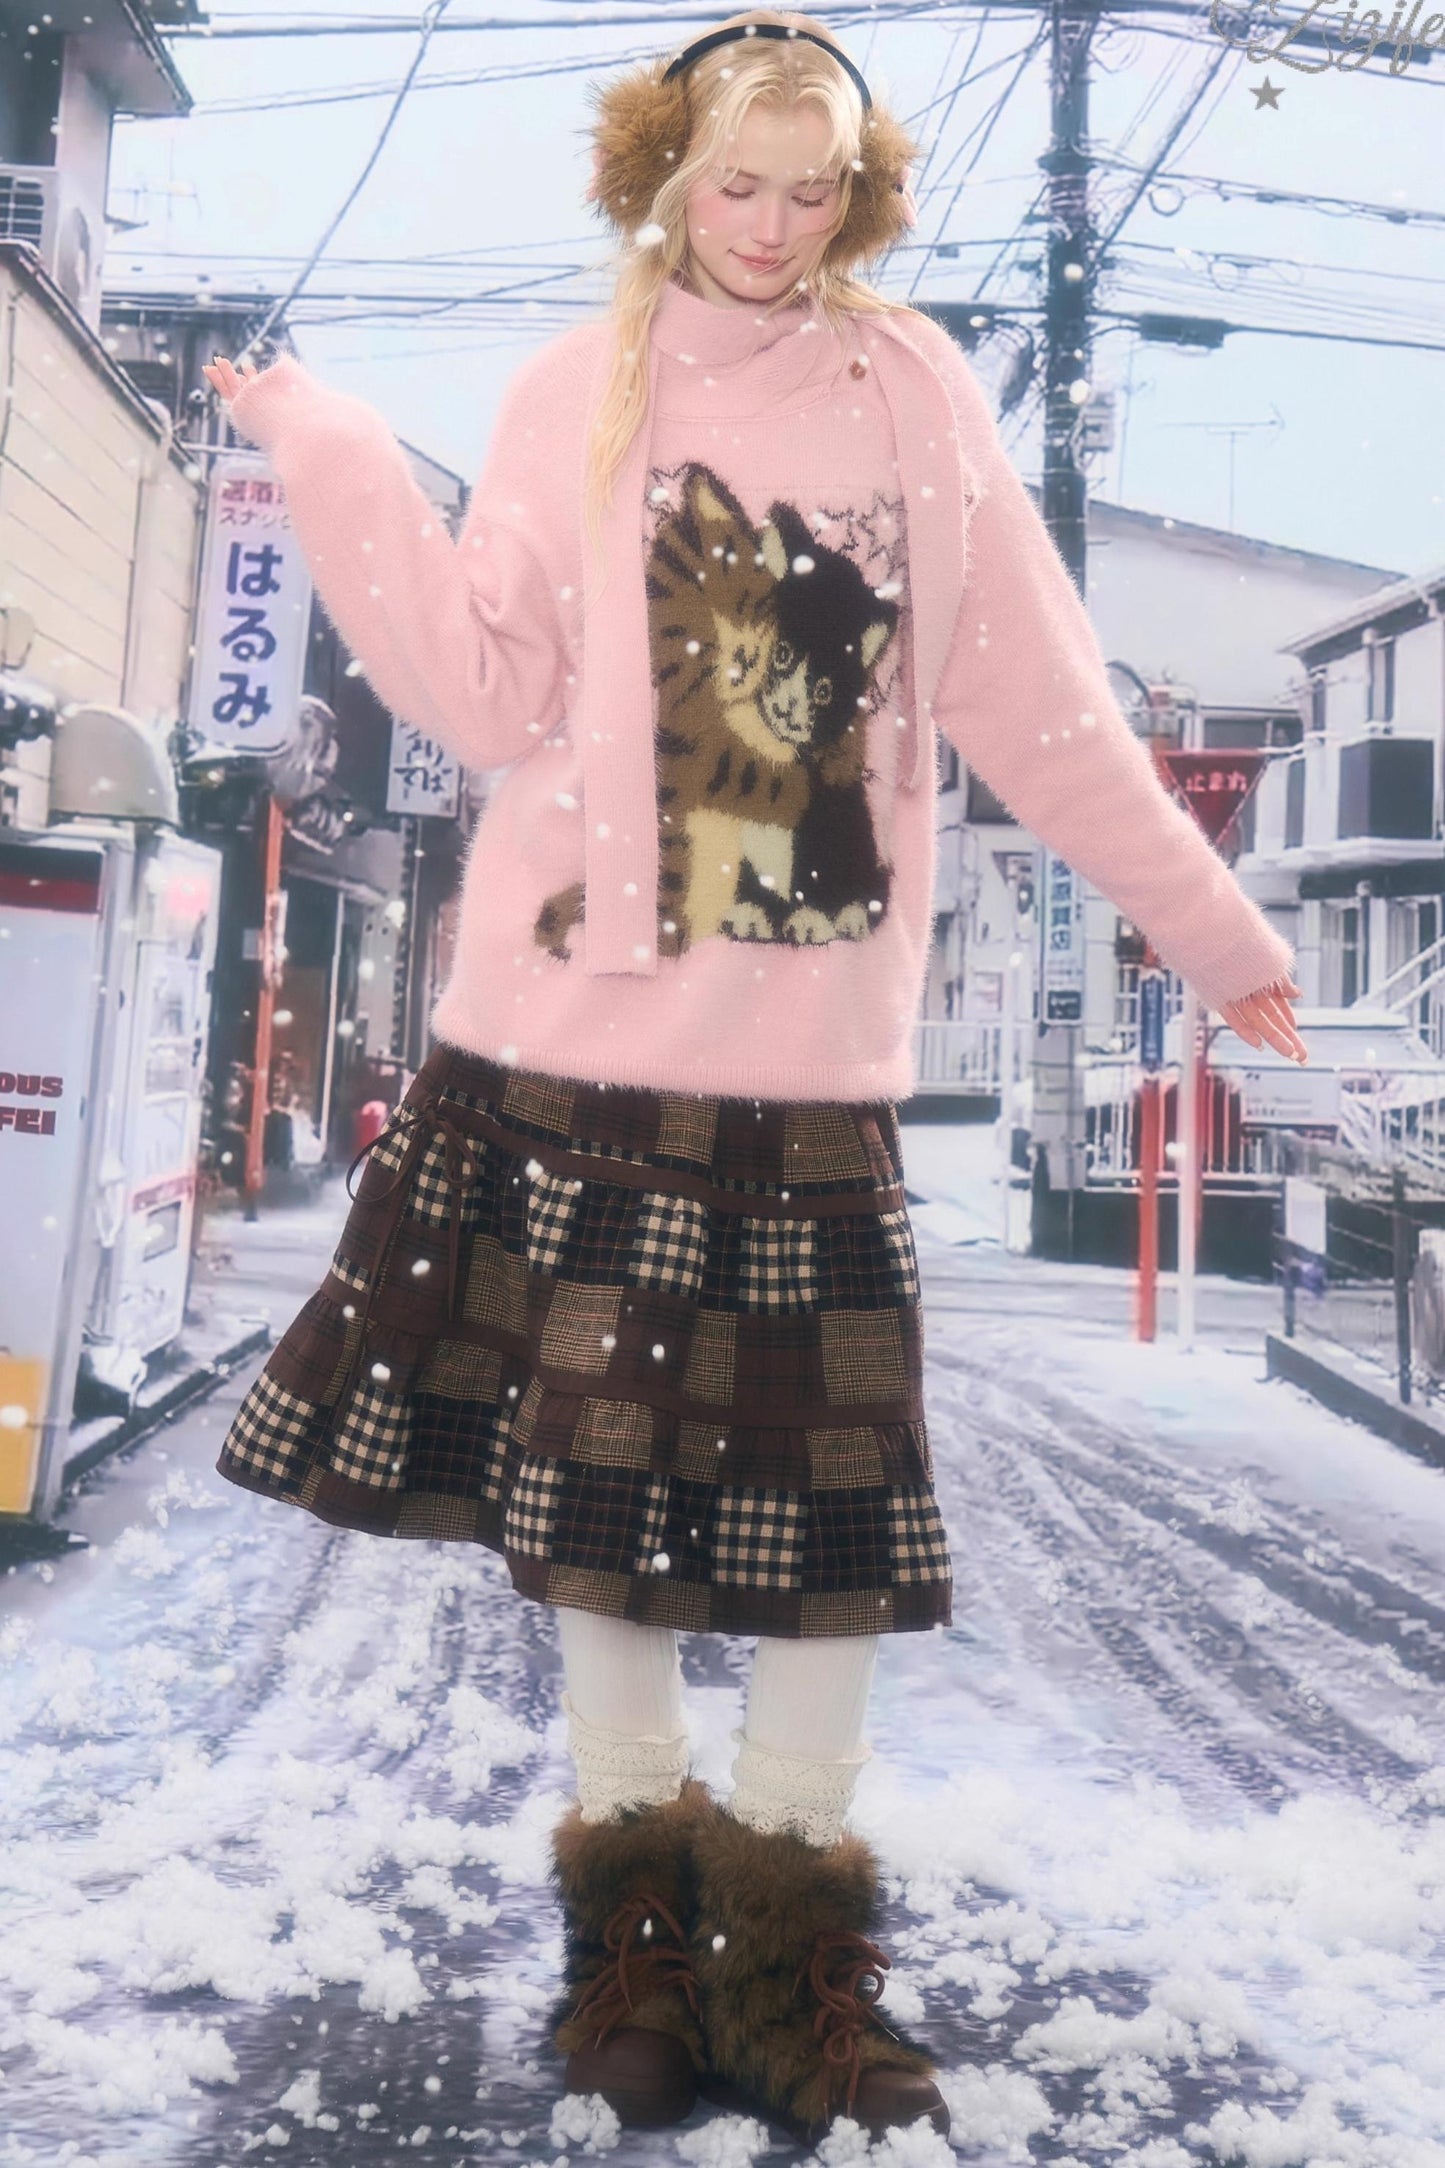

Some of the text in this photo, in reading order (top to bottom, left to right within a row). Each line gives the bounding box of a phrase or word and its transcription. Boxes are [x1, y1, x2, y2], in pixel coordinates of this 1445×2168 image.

[211, 541, 283, 729] はるみ
[1185, 771, 1248, 793] 止まれ
